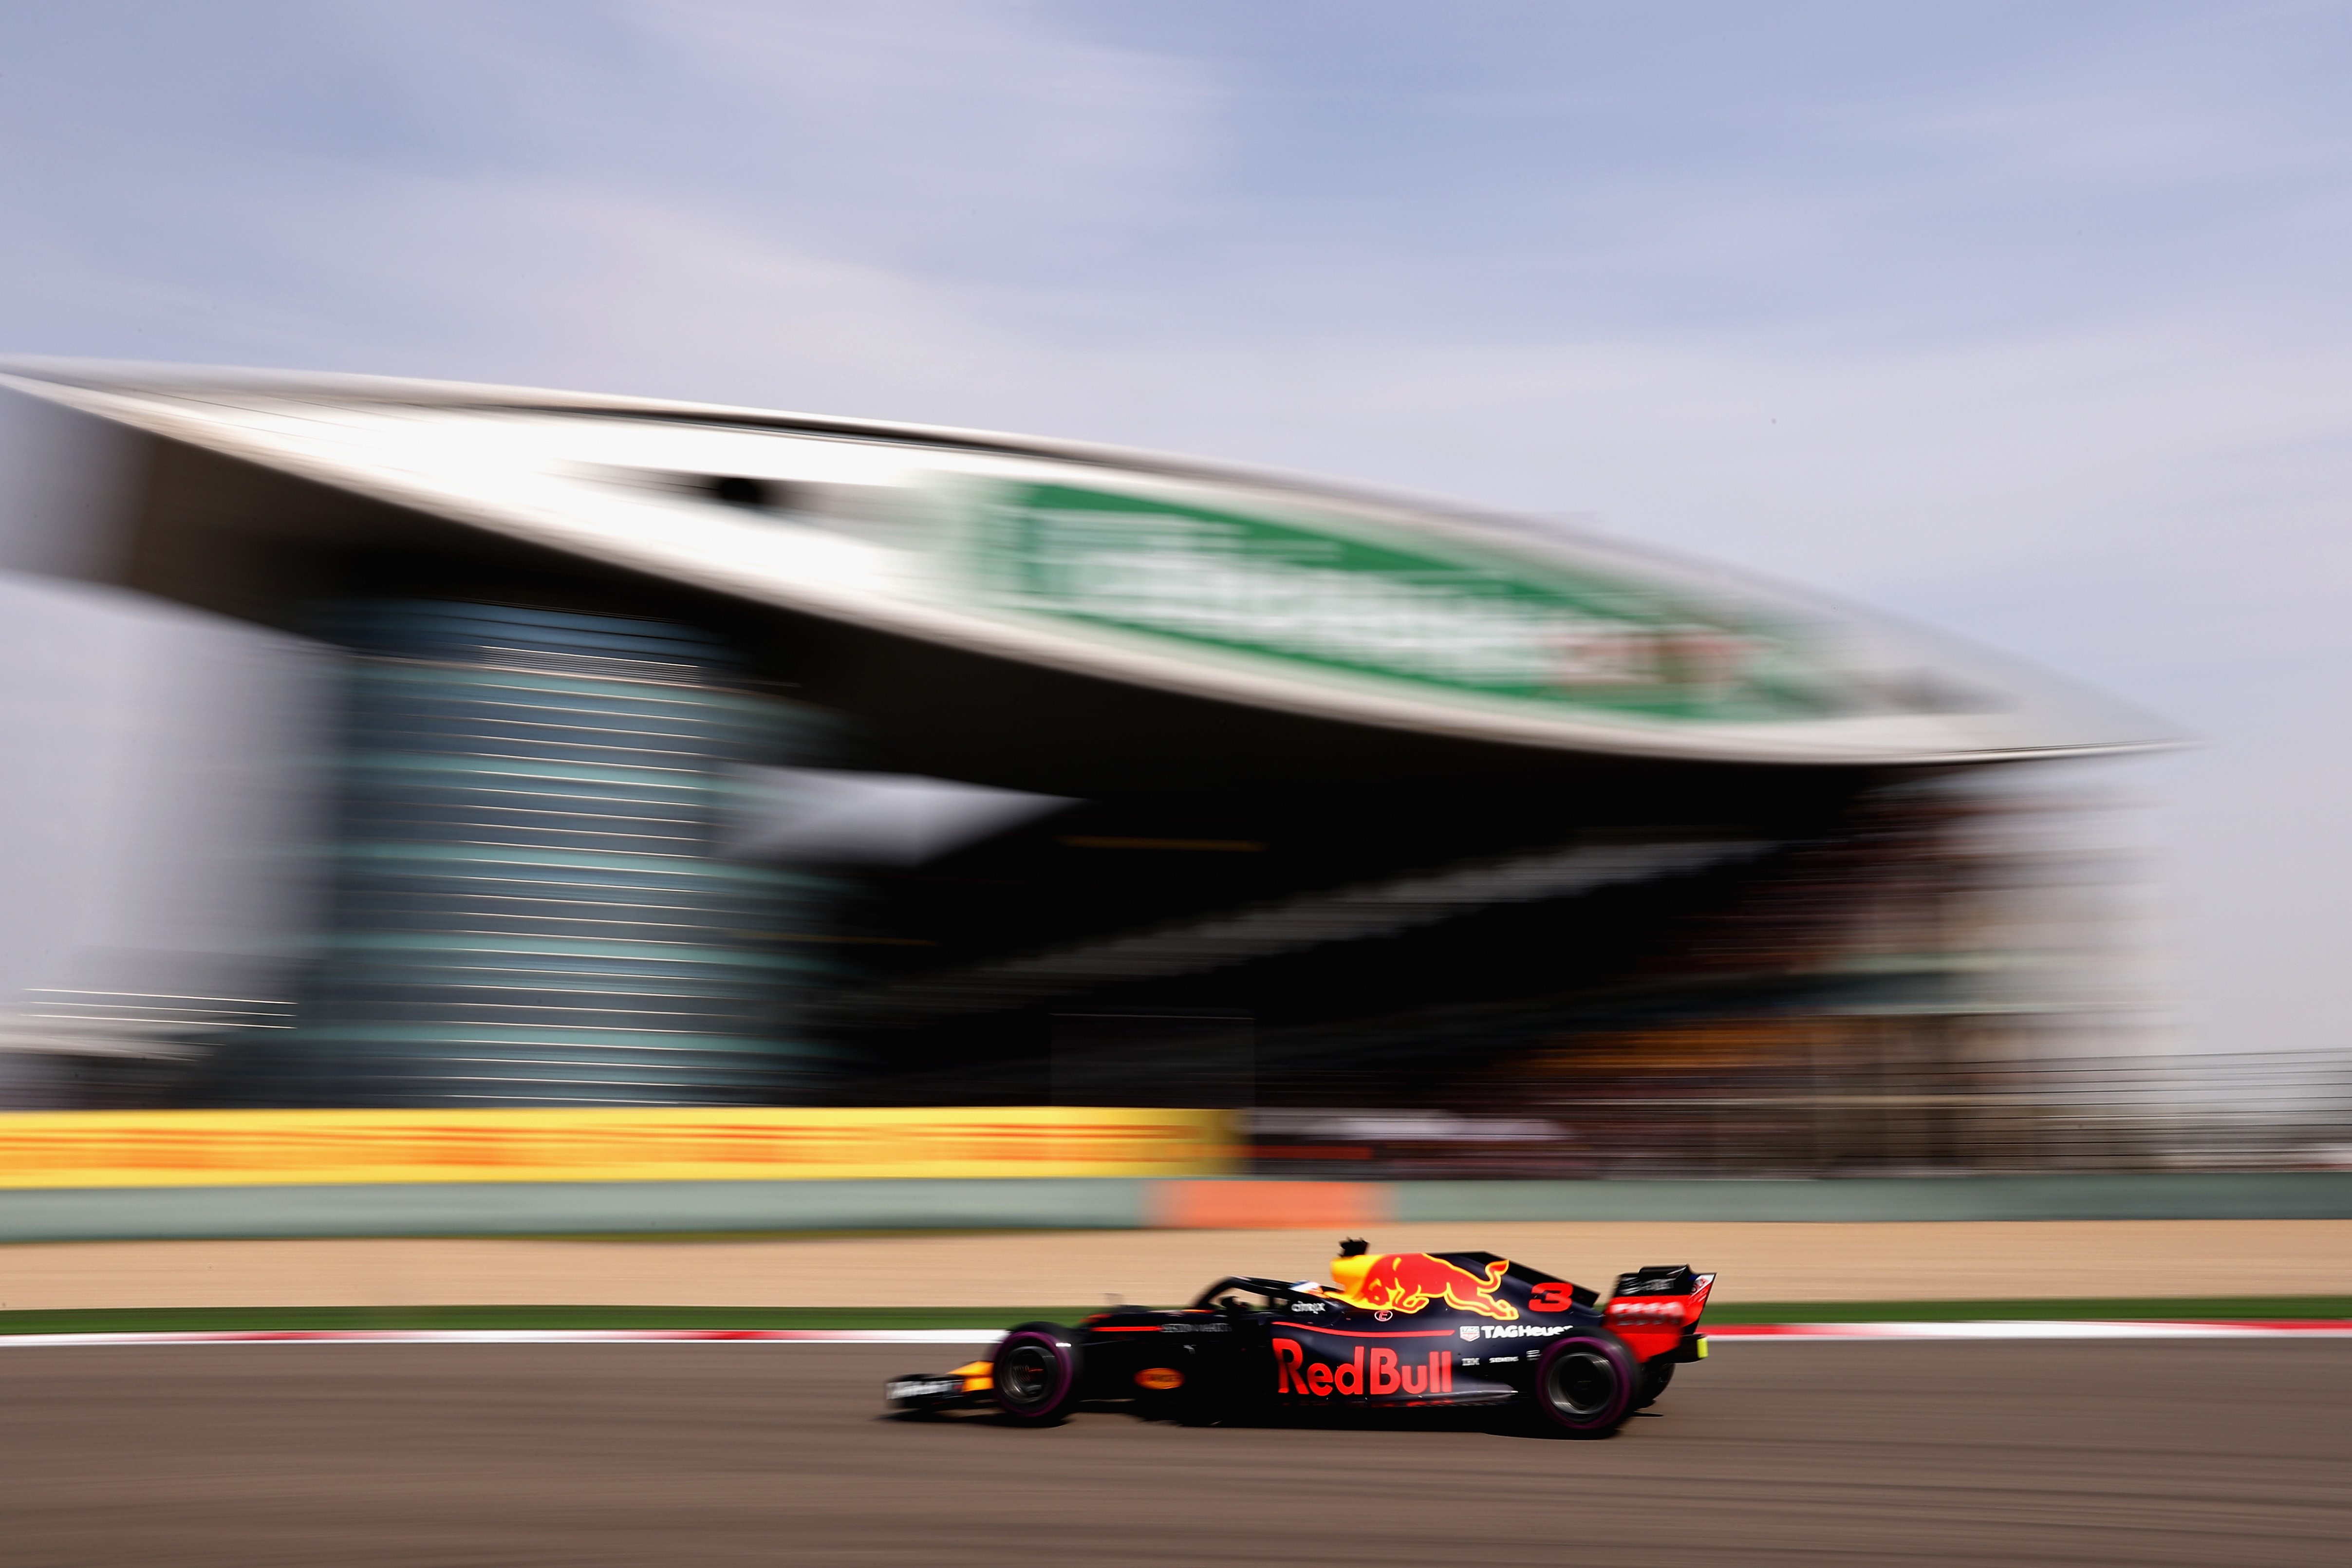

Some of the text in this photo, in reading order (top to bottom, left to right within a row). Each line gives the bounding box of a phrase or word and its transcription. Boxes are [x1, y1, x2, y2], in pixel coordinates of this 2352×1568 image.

[1529, 1282, 1573, 1312] 3
[1272, 1338, 1452, 1396] Red Bull
